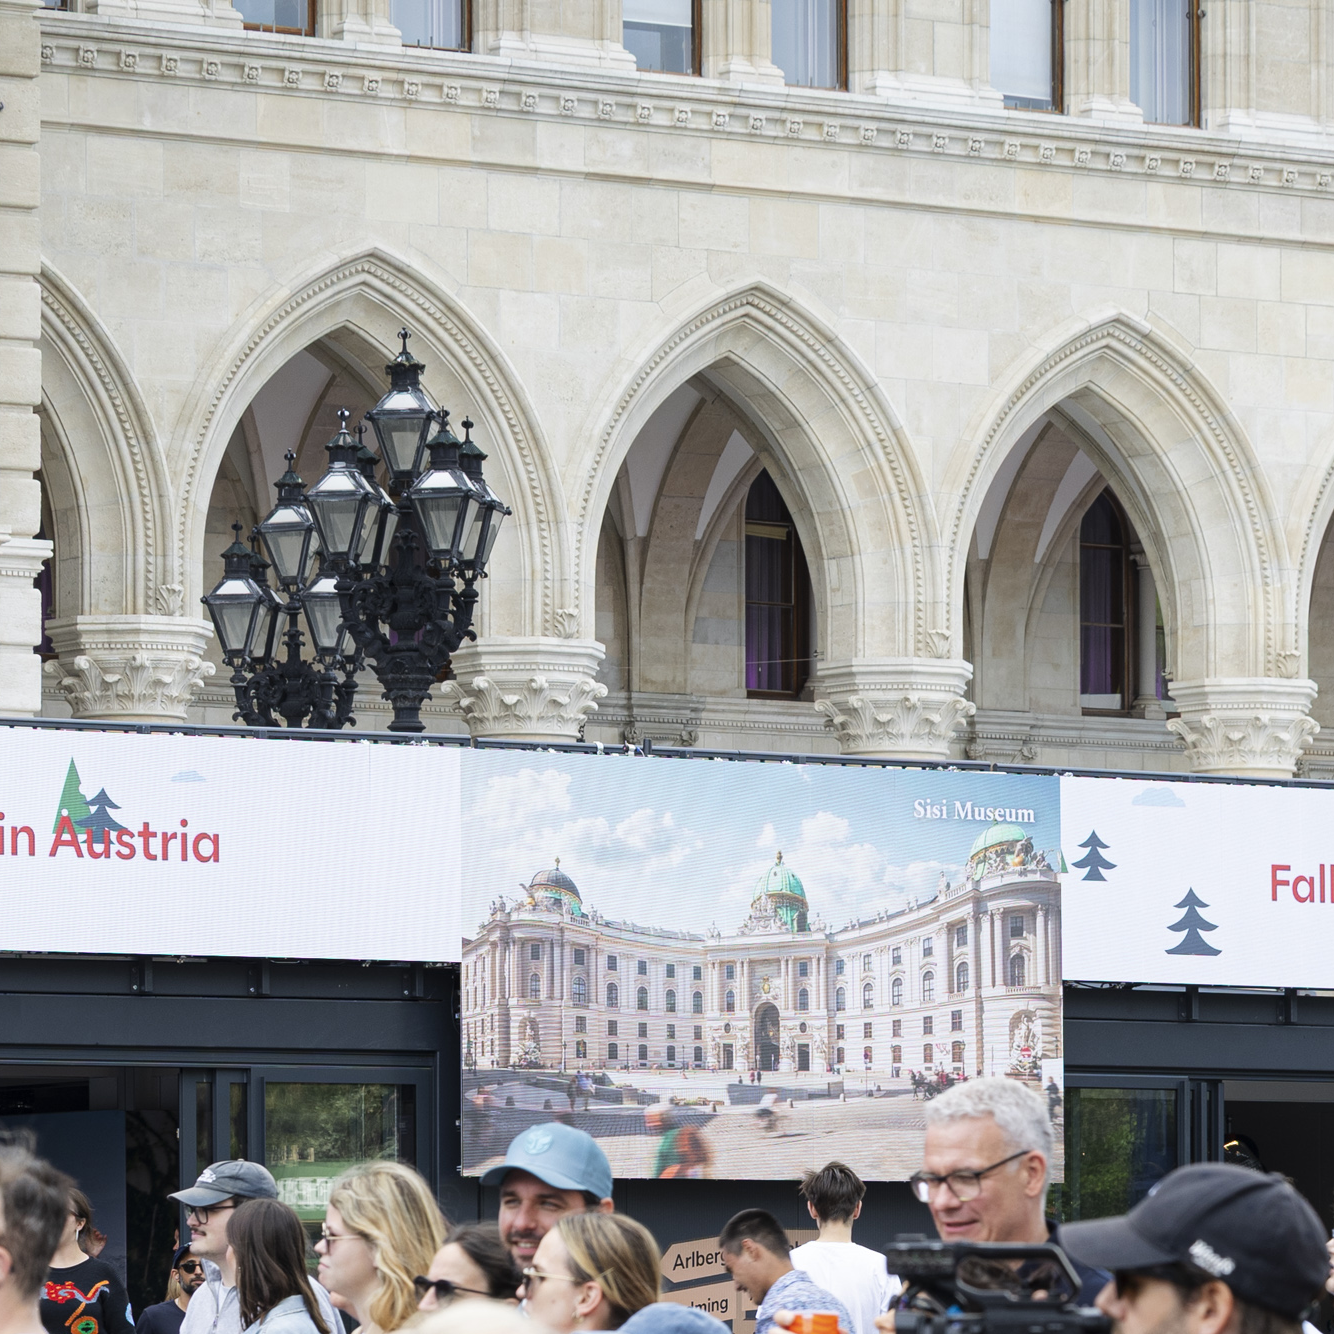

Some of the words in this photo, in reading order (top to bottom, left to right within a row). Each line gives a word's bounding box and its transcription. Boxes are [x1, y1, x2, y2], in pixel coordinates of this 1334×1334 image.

[913, 798, 948, 819] Sisi
[954, 801, 1036, 823] Museum
[50, 816, 218, 861] Austria
[1272, 864, 1334, 903] Fall
